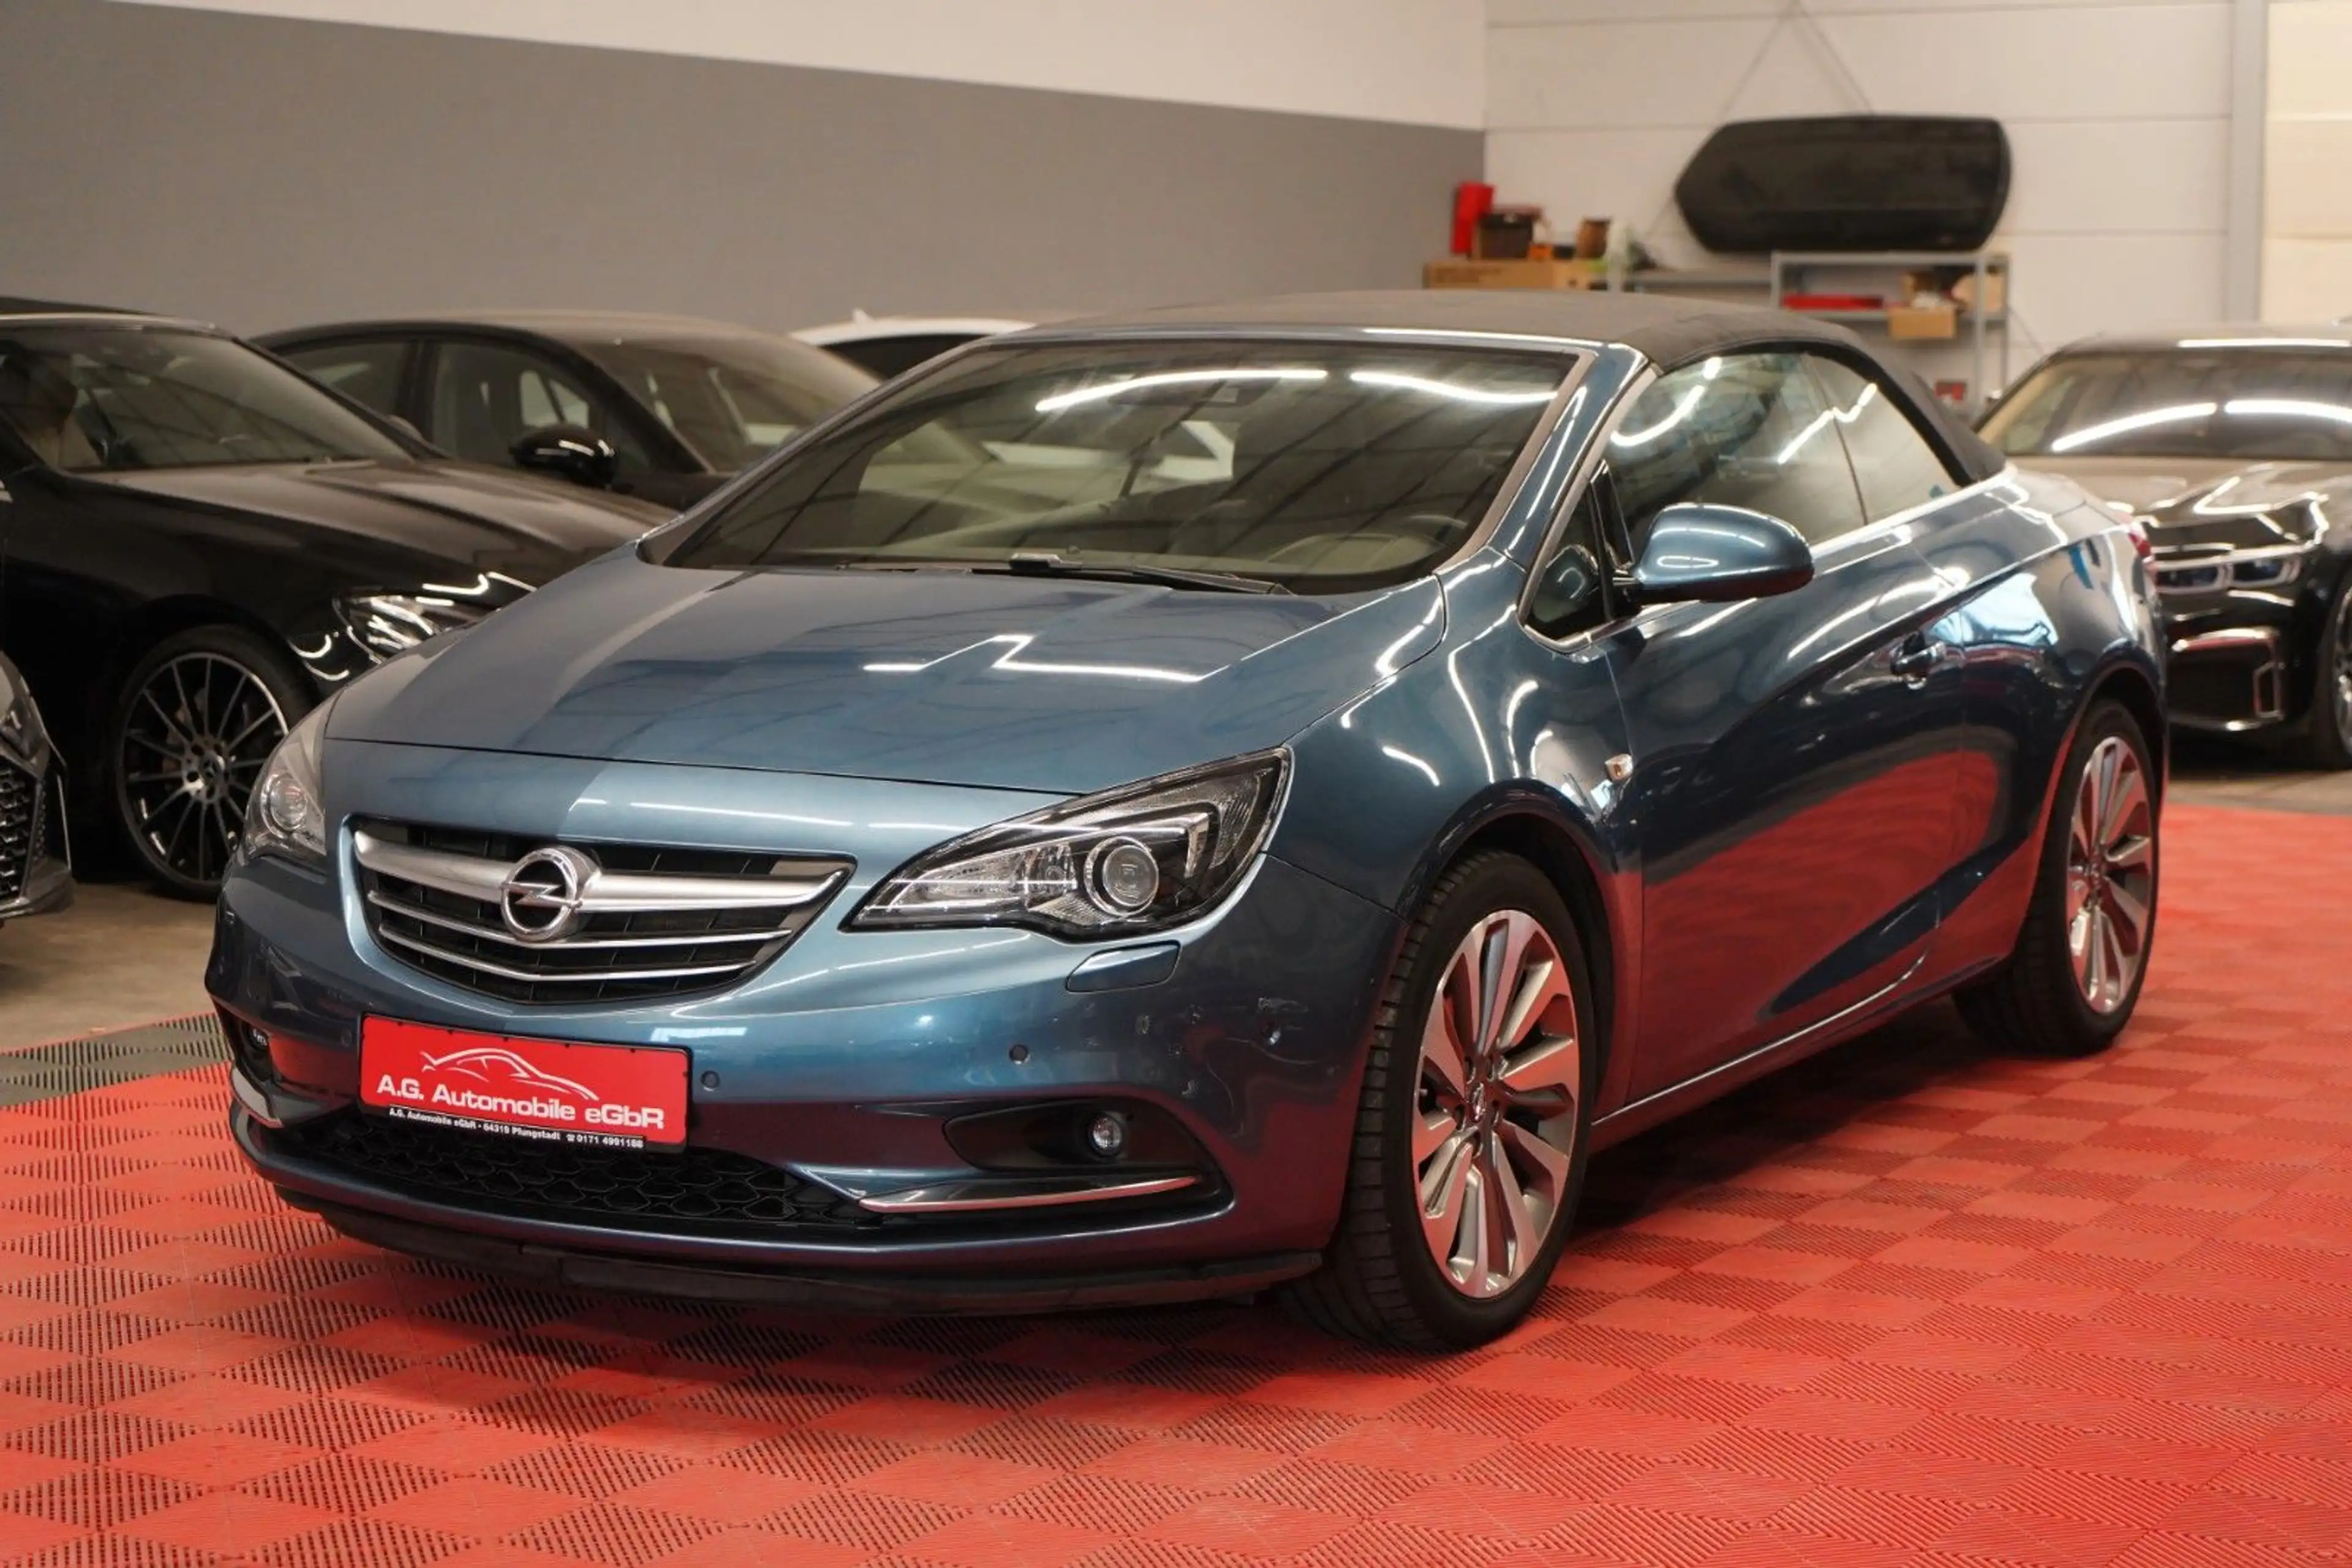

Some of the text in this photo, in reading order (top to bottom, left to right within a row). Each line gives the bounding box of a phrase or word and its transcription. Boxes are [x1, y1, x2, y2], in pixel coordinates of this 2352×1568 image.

[377, 1074, 664, 1129] A.G. Automobile eGbR
[390, 1107, 405, 1118] A.G.
[407, 1110, 452, 1125] Automobile
[576, 1134, 599, 1144] 0171
